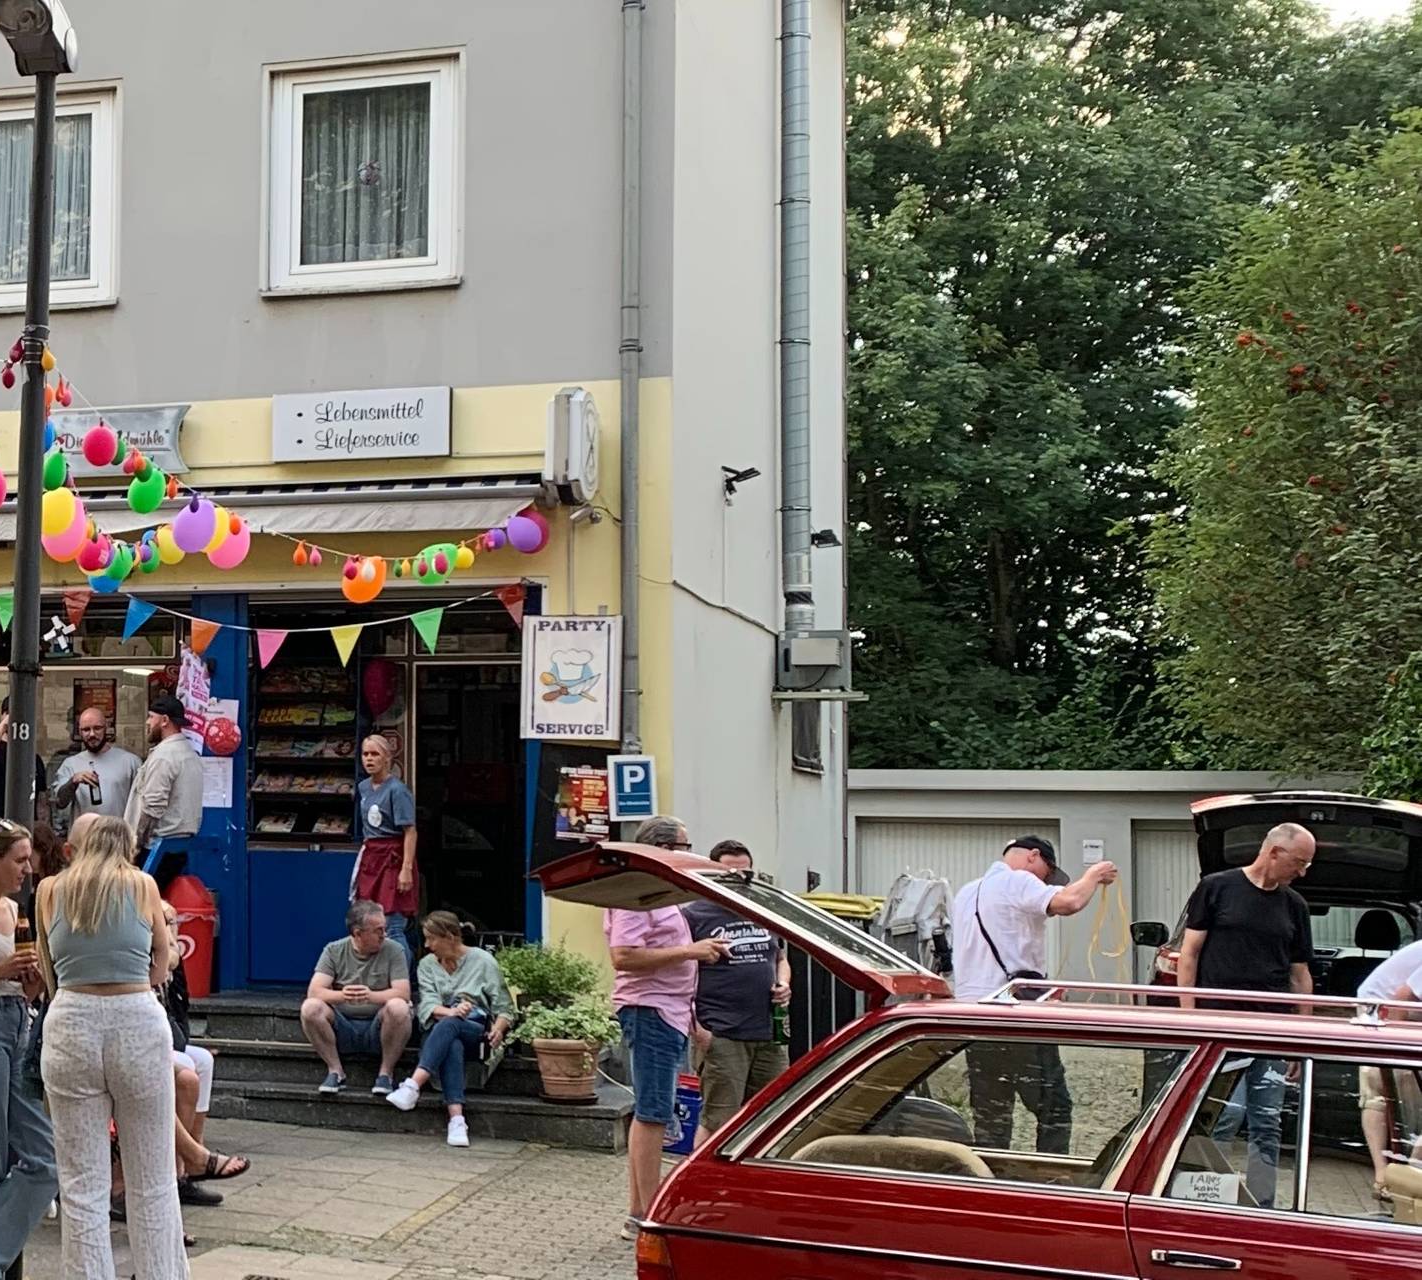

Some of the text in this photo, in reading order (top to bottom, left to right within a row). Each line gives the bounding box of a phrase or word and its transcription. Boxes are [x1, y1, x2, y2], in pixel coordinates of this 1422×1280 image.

[315, 398, 424, 424] Lebensmittel
[315, 428, 419, 454] Lieferservice
[538, 620, 606, 631] PARTY
[12, 722, 30, 740] 18
[535, 723, 604, 735] SERVICE
[623, 765, 645, 792] P
